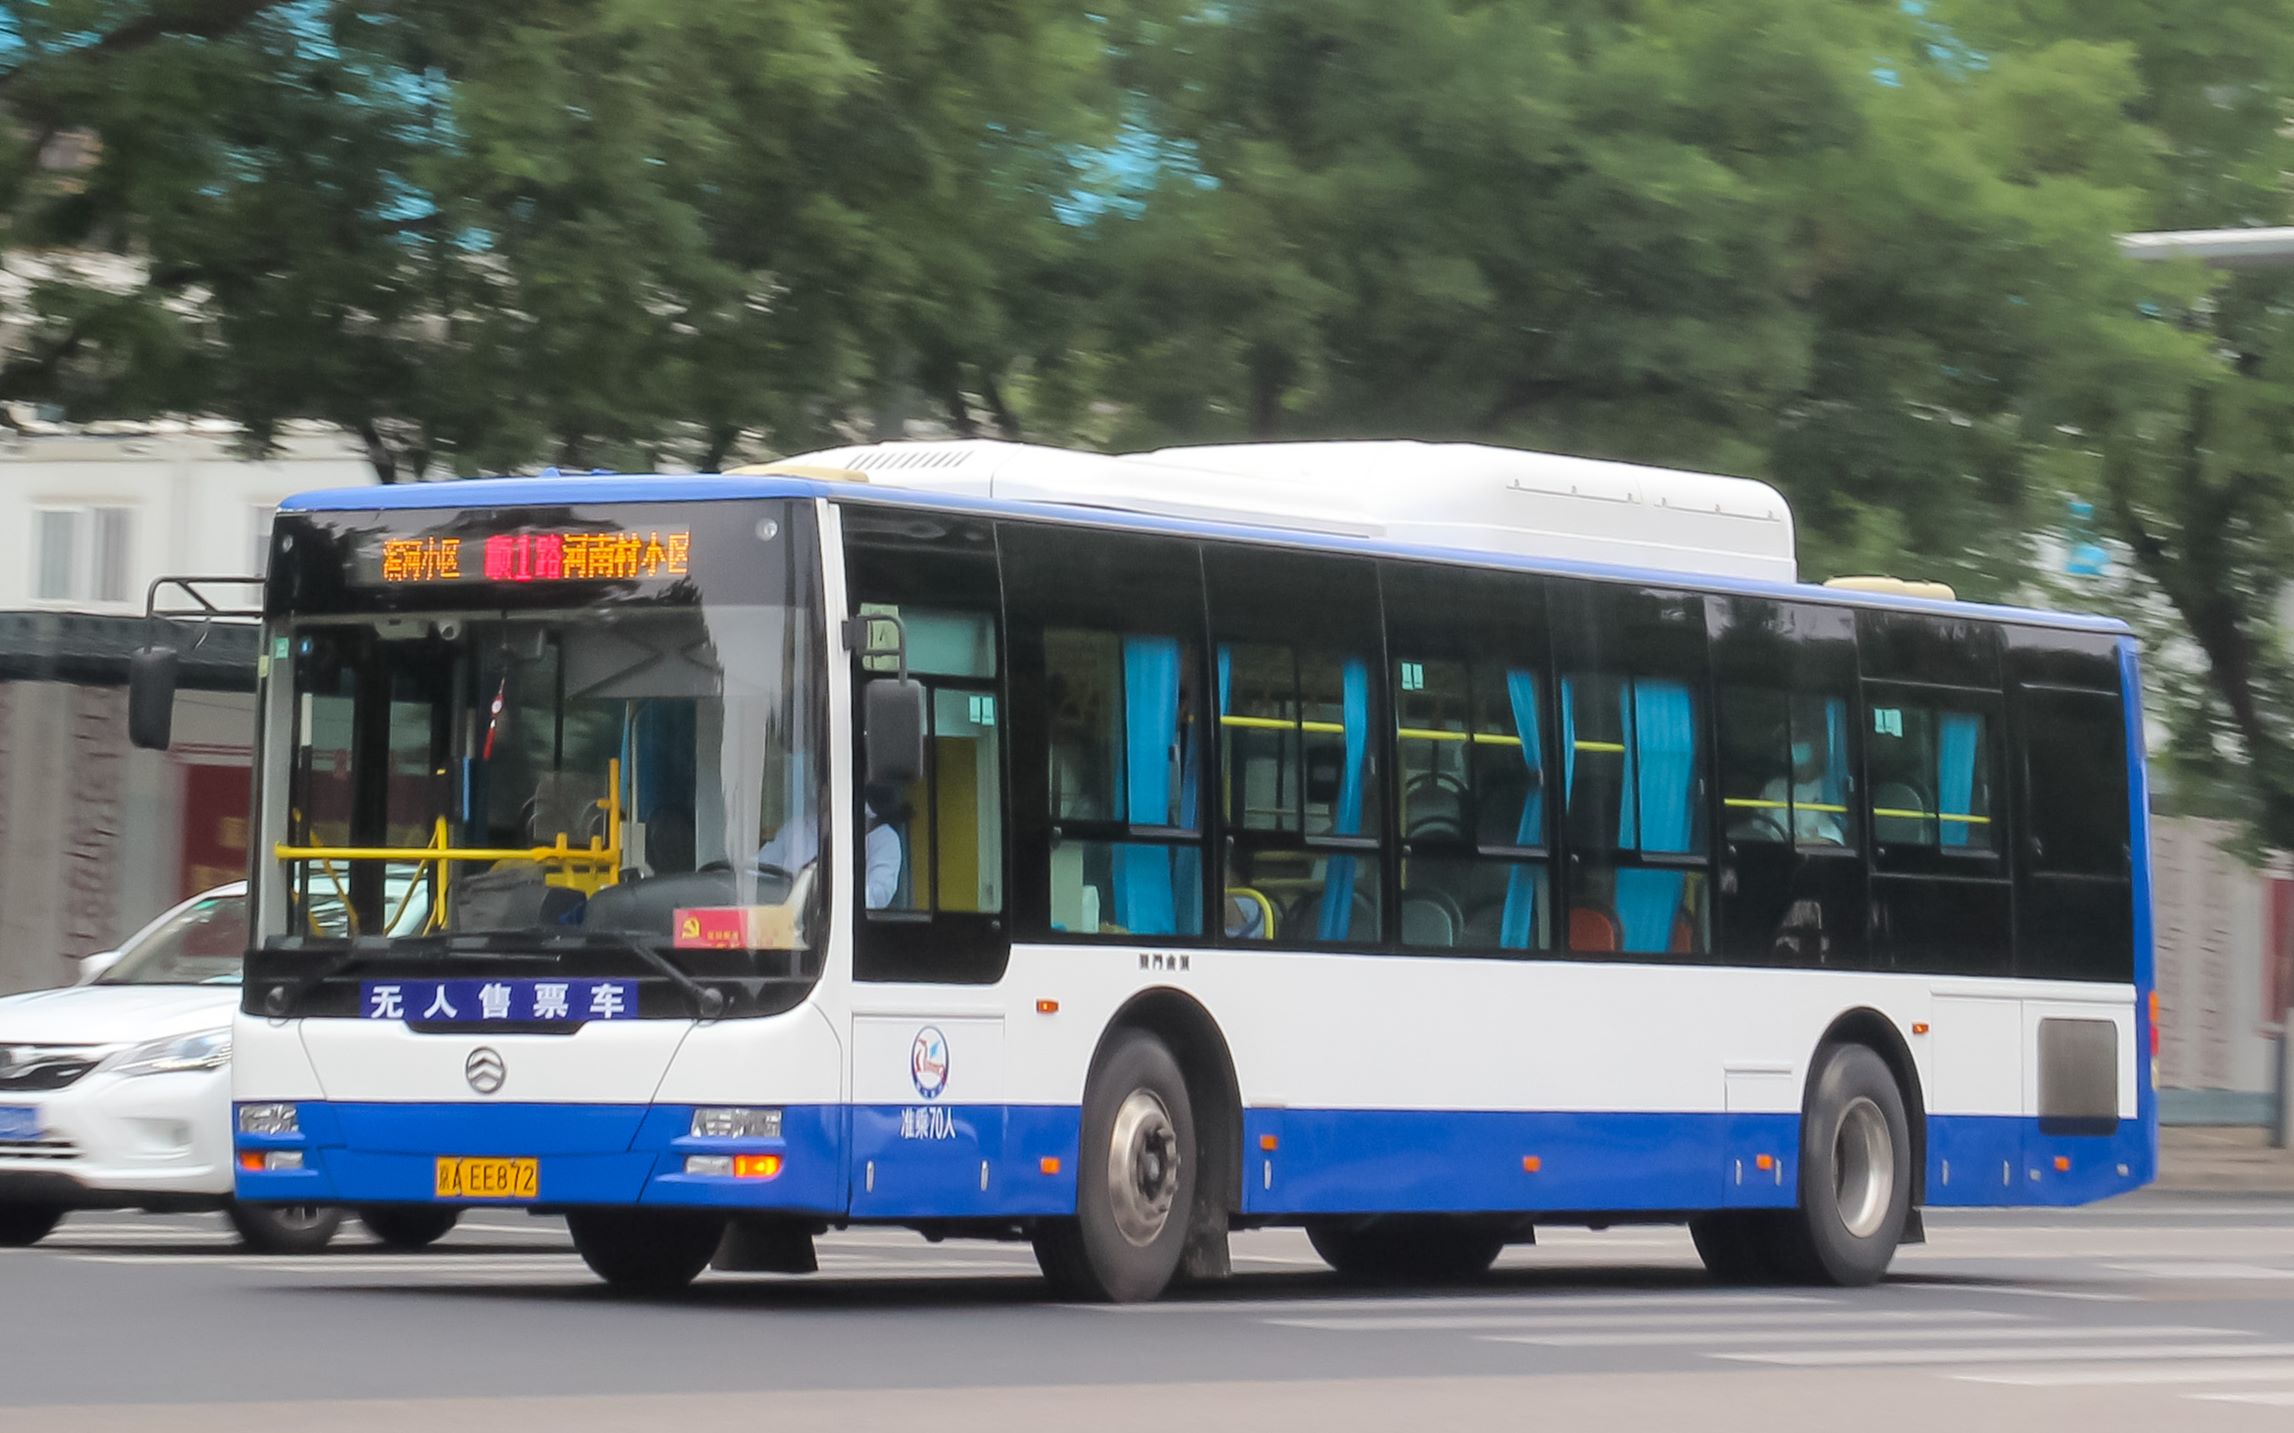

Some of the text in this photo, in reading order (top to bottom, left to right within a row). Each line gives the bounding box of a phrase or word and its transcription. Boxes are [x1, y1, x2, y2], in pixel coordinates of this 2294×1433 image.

[370, 982, 625, 1019] 无人售票车
